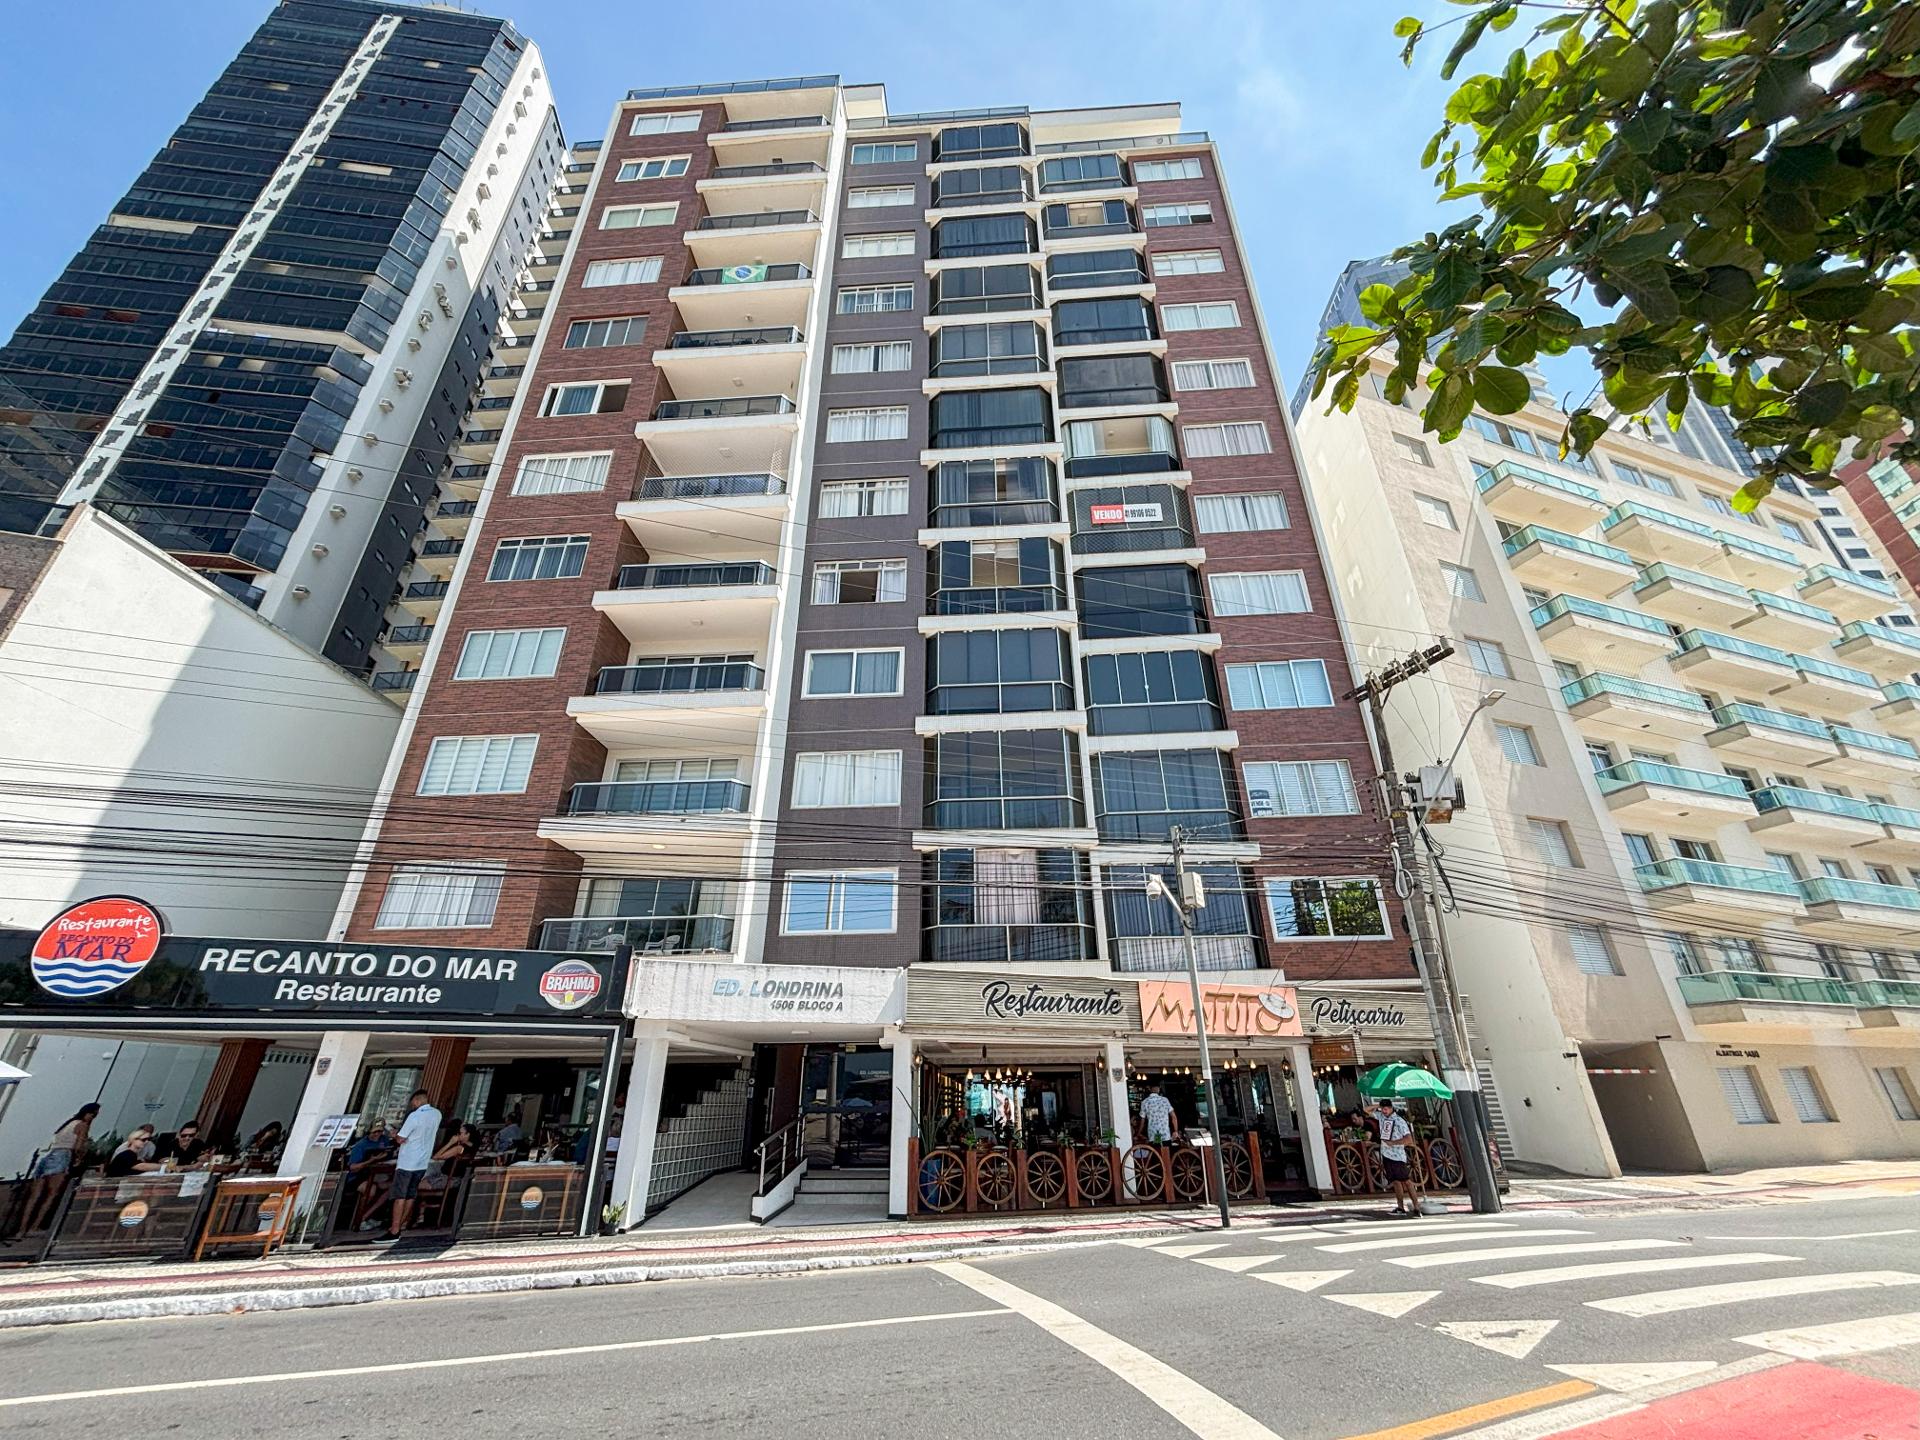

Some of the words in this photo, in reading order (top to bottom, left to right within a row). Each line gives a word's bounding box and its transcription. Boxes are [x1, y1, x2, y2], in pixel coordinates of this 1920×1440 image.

[1093, 509, 1122, 520] VENDO
[58, 914, 151, 932] Restaurante
[58, 933, 112, 945] RECANTO
[114, 936, 135, 944] DO
[51, 941, 131, 961] MAR
[199, 948, 377, 976] RECANTO
[386, 954, 436, 978] DO
[444, 957, 518, 981] MAR
[274, 979, 442, 1004] Restaurante
[545, 976, 595, 991] BRAHMA
[713, 979, 744, 997] ED.
[749, 980, 844, 998] LONDRINA
[797, 1000, 833, 1012] BLOCO
[835, 1001, 843, 1011] A
[981, 980, 1124, 1019] Restaurante
[1310, 997, 1406, 1026] Petiscaria
